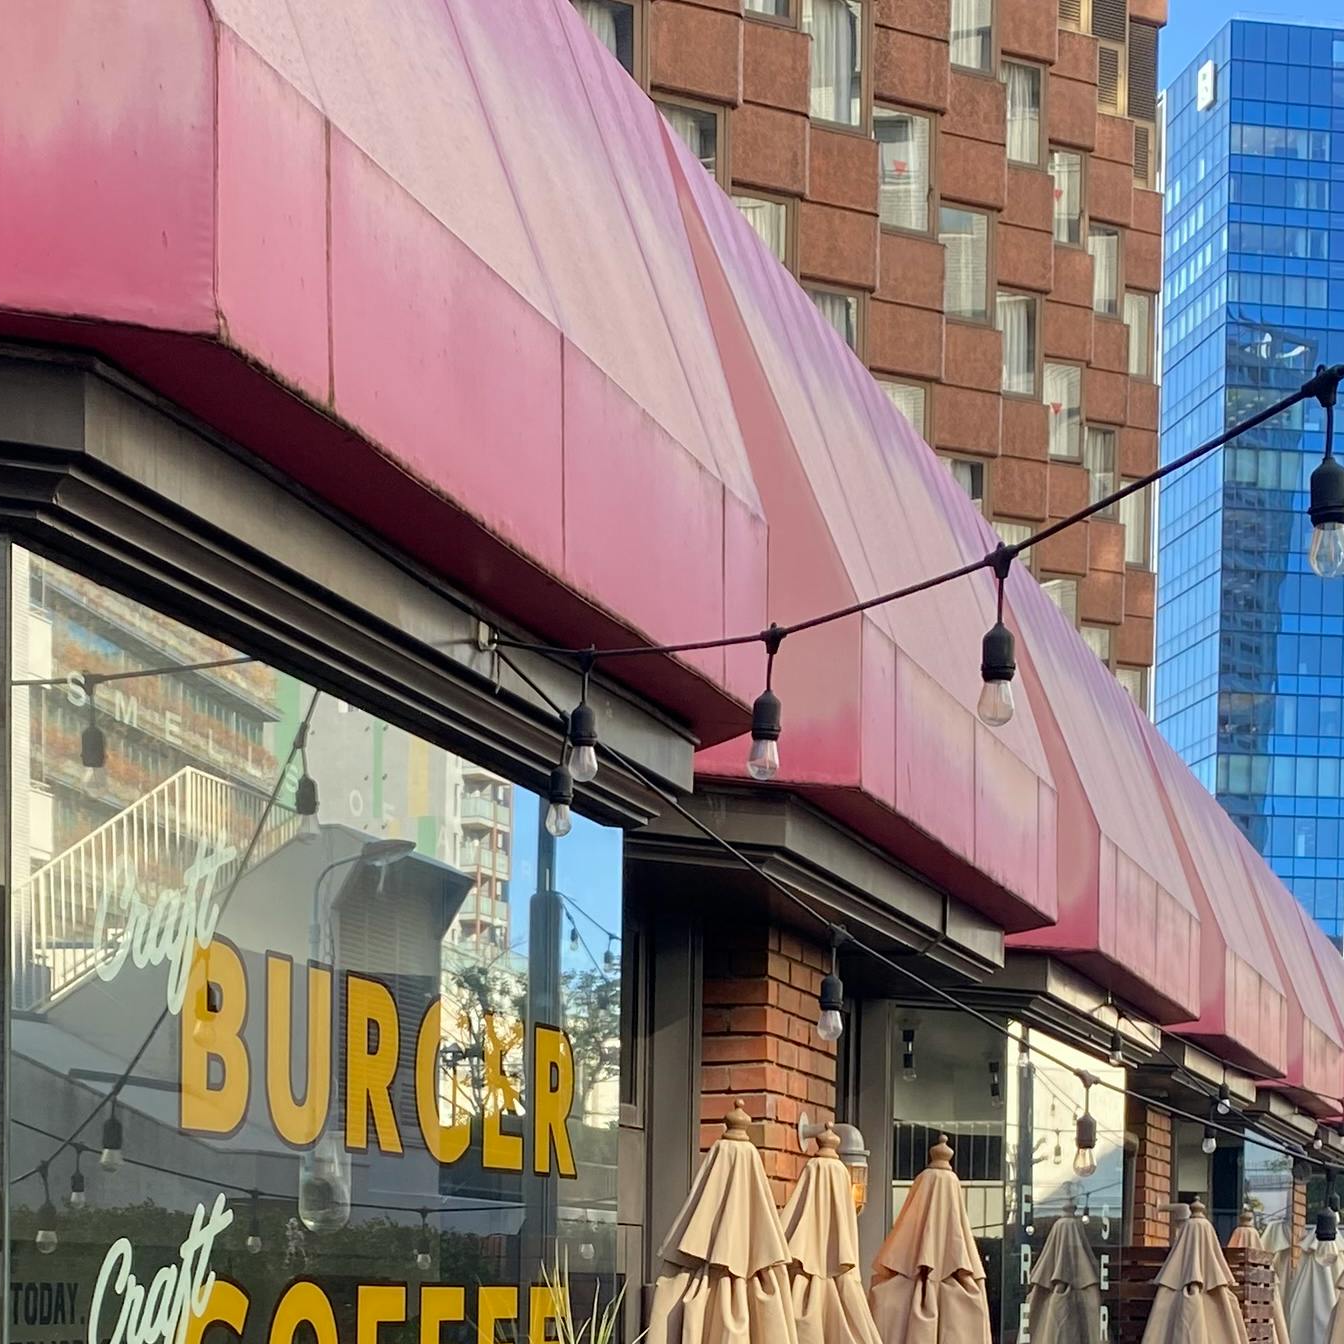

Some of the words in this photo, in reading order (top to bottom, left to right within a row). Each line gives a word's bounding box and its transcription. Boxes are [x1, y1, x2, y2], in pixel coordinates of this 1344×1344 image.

[93, 828, 237, 1015] Craft
[180, 933, 577, 1178] BURGER
[9, 1282, 85, 1325] TODAY.
